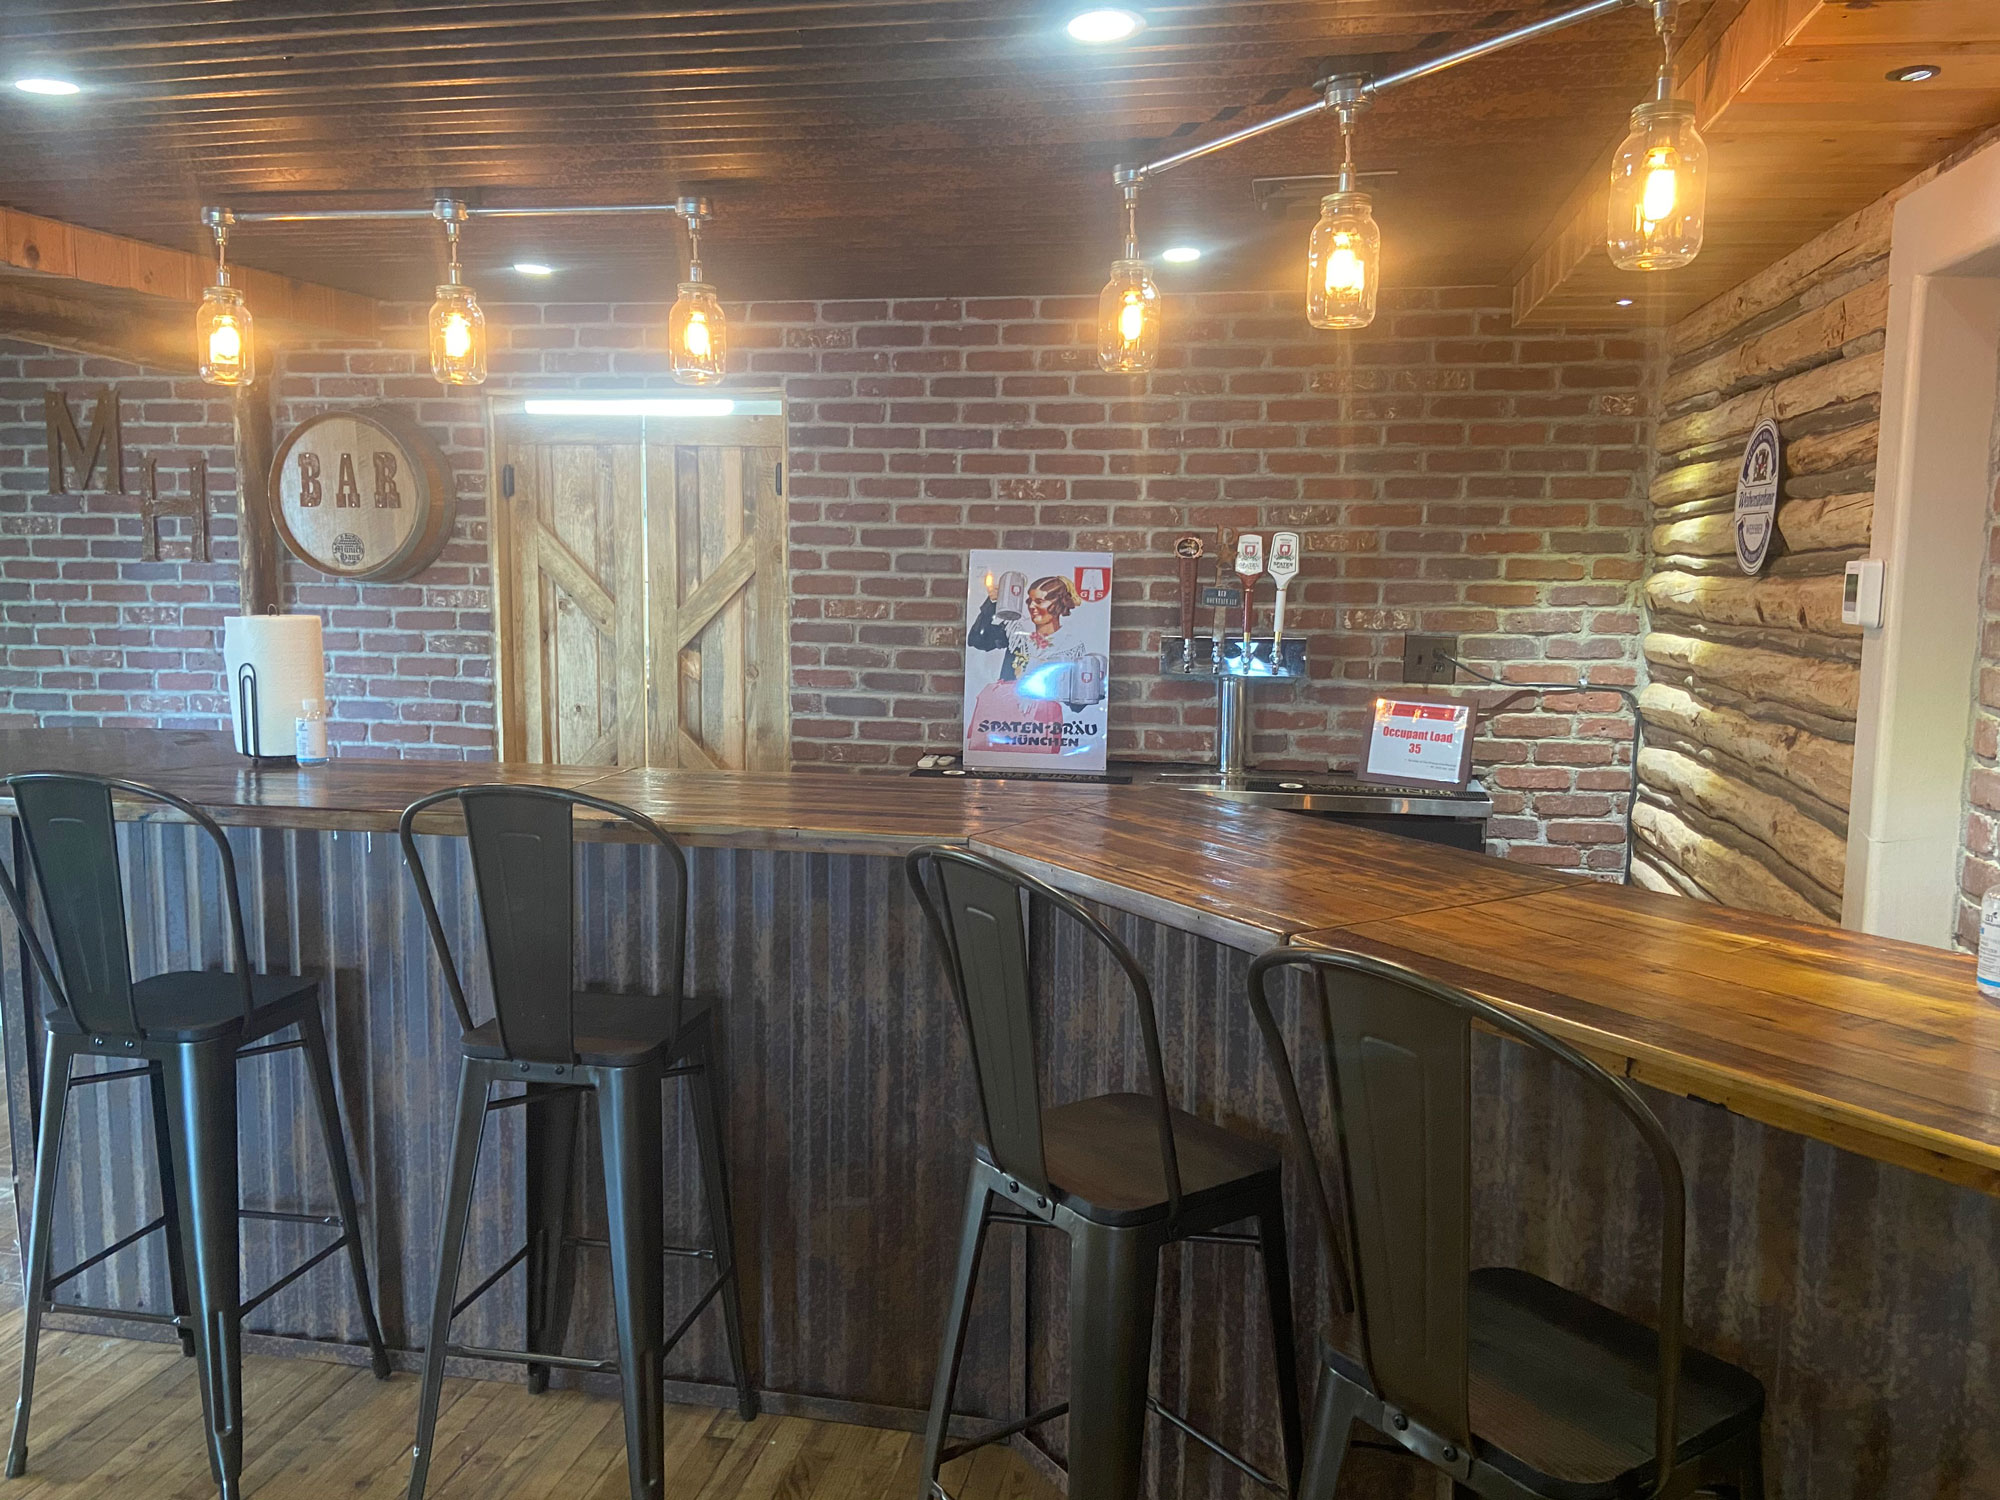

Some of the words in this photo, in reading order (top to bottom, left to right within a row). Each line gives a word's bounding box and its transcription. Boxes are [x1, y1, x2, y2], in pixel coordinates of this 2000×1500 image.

[45, 390, 123, 496] M
[297, 452, 402, 509] BAR
[139, 457, 209, 562] H
[1080, 591, 1088, 599] G
[977, 719, 1098, 736] SPATEN-BRÄU
[1383, 726, 1428, 740] Occupant
[1430, 731, 1453, 743] Load
[1408, 743, 1421, 754] 35
